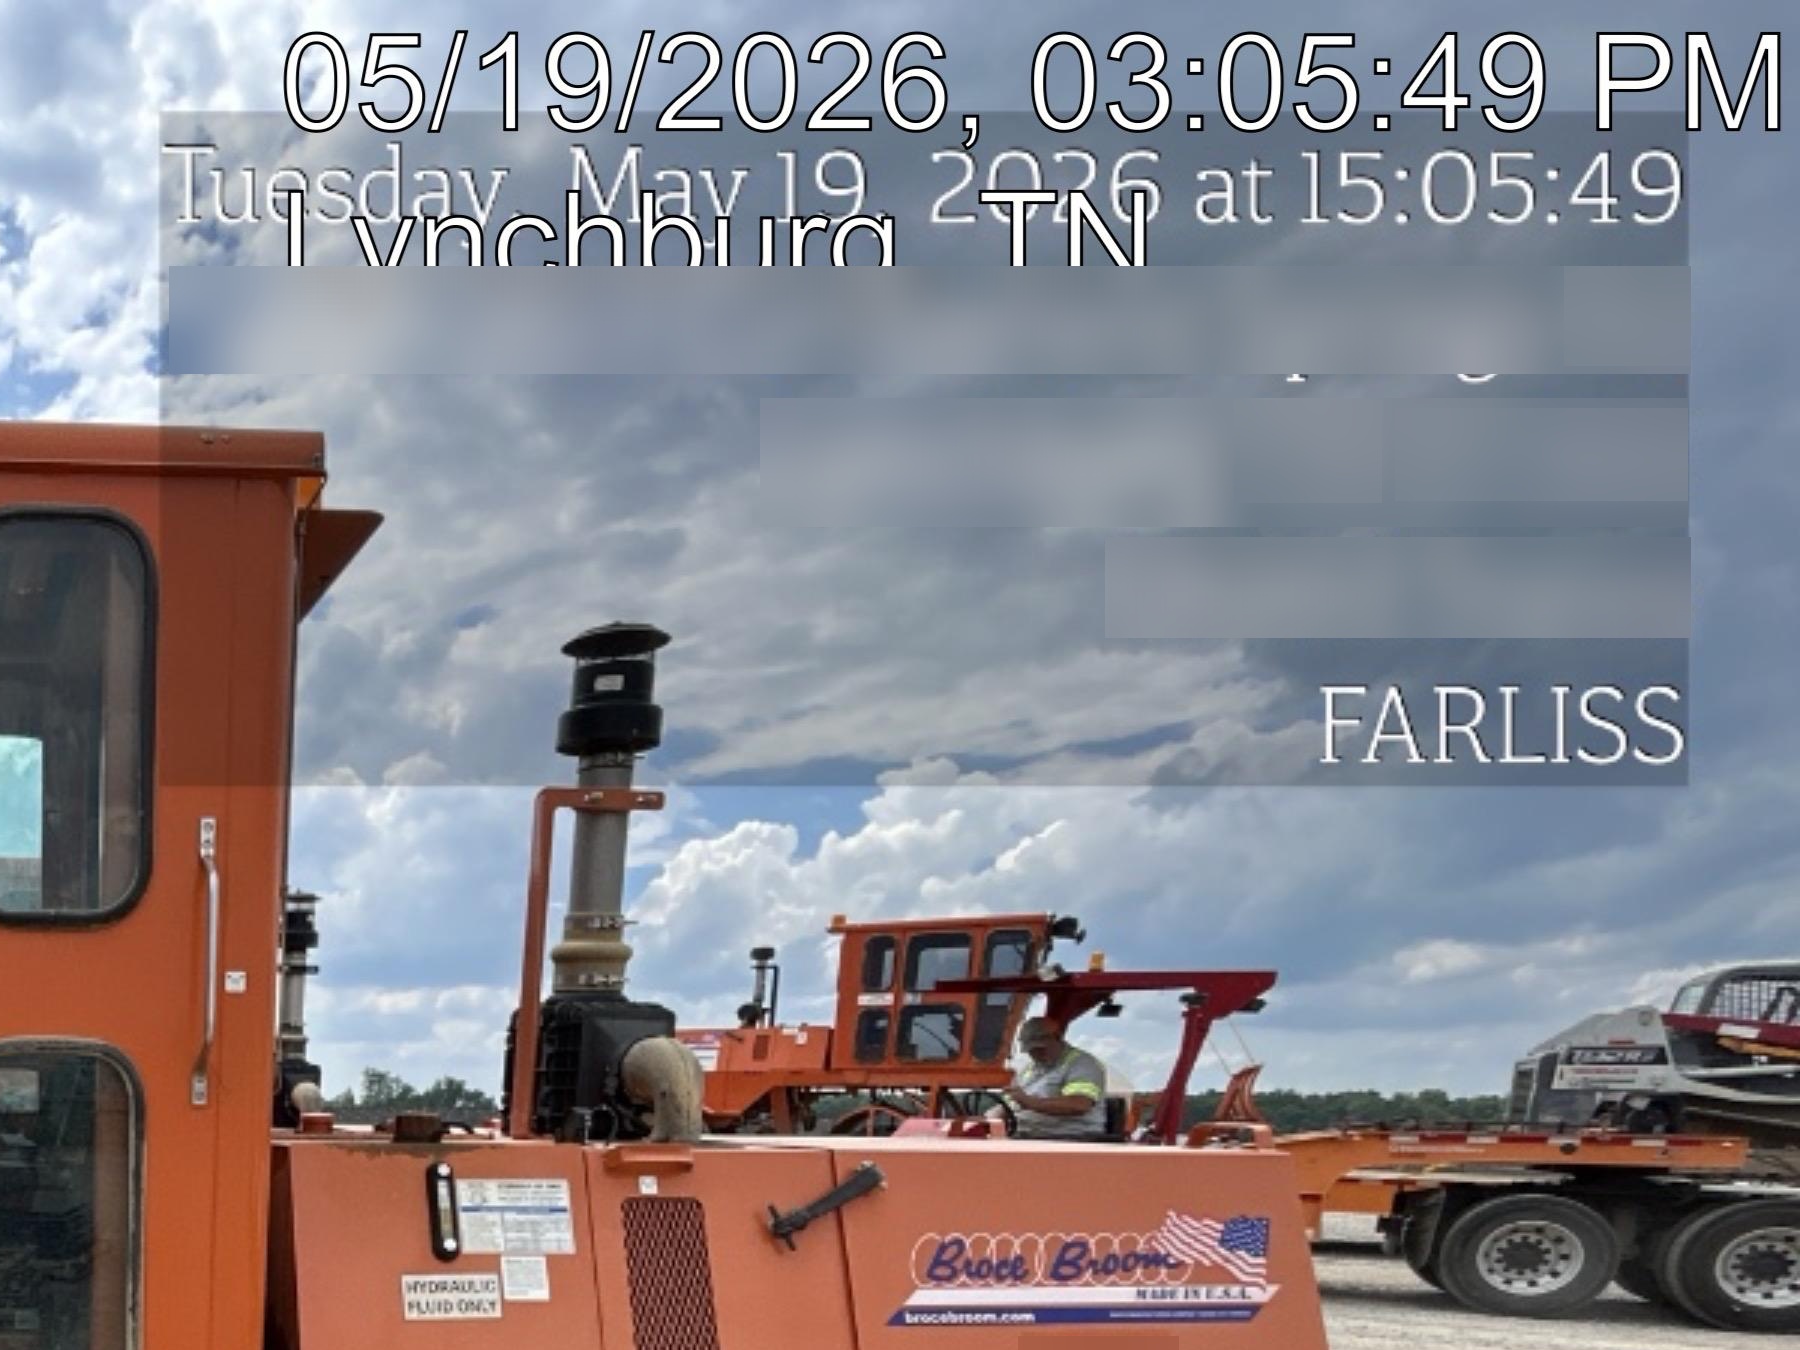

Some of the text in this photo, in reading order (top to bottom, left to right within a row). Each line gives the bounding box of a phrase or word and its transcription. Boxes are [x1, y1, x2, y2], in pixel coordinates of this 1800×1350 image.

[927, 1237, 1184, 1283] Broce Broom
[406, 1280, 496, 1294] HYDRAULIC
[408, 1299, 496, 1315] FLUID ONLY
